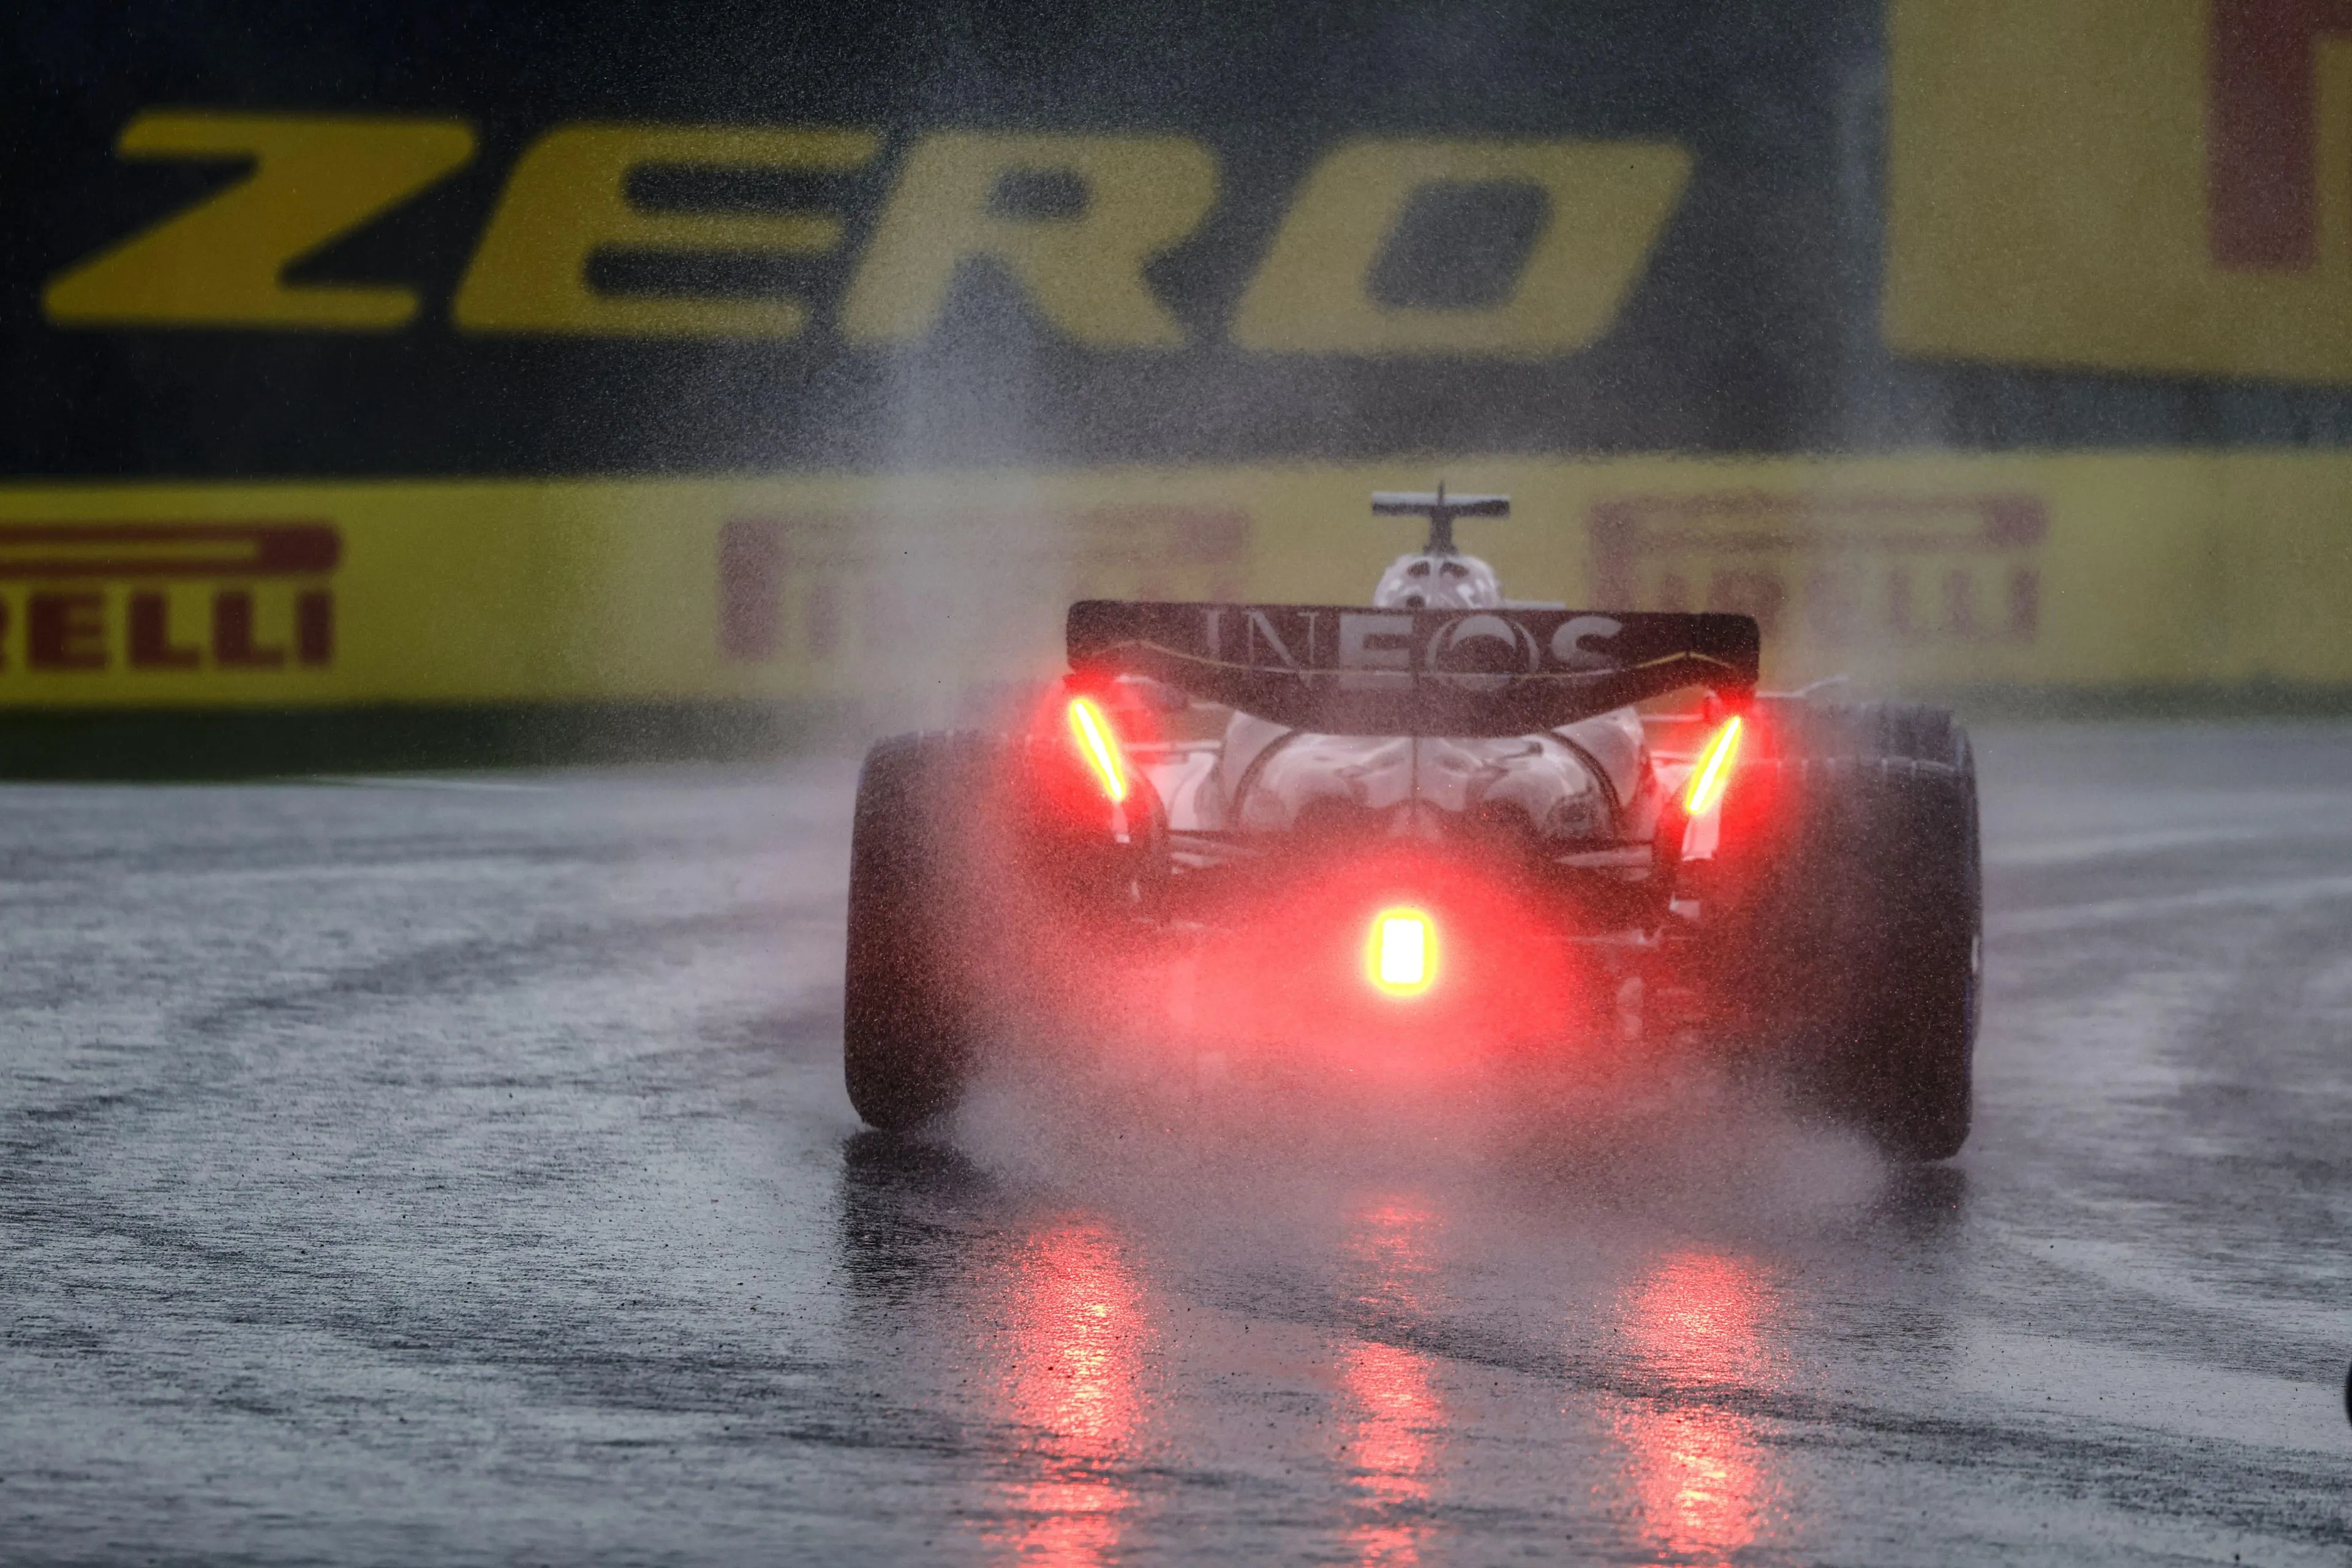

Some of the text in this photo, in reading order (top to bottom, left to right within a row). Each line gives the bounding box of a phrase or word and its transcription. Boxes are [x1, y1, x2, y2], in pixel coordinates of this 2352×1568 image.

[42, 111, 1695, 360] ZERO
[0, 592, 336, 670] ELLI
[1199, 609, 1623, 692] INEOS
